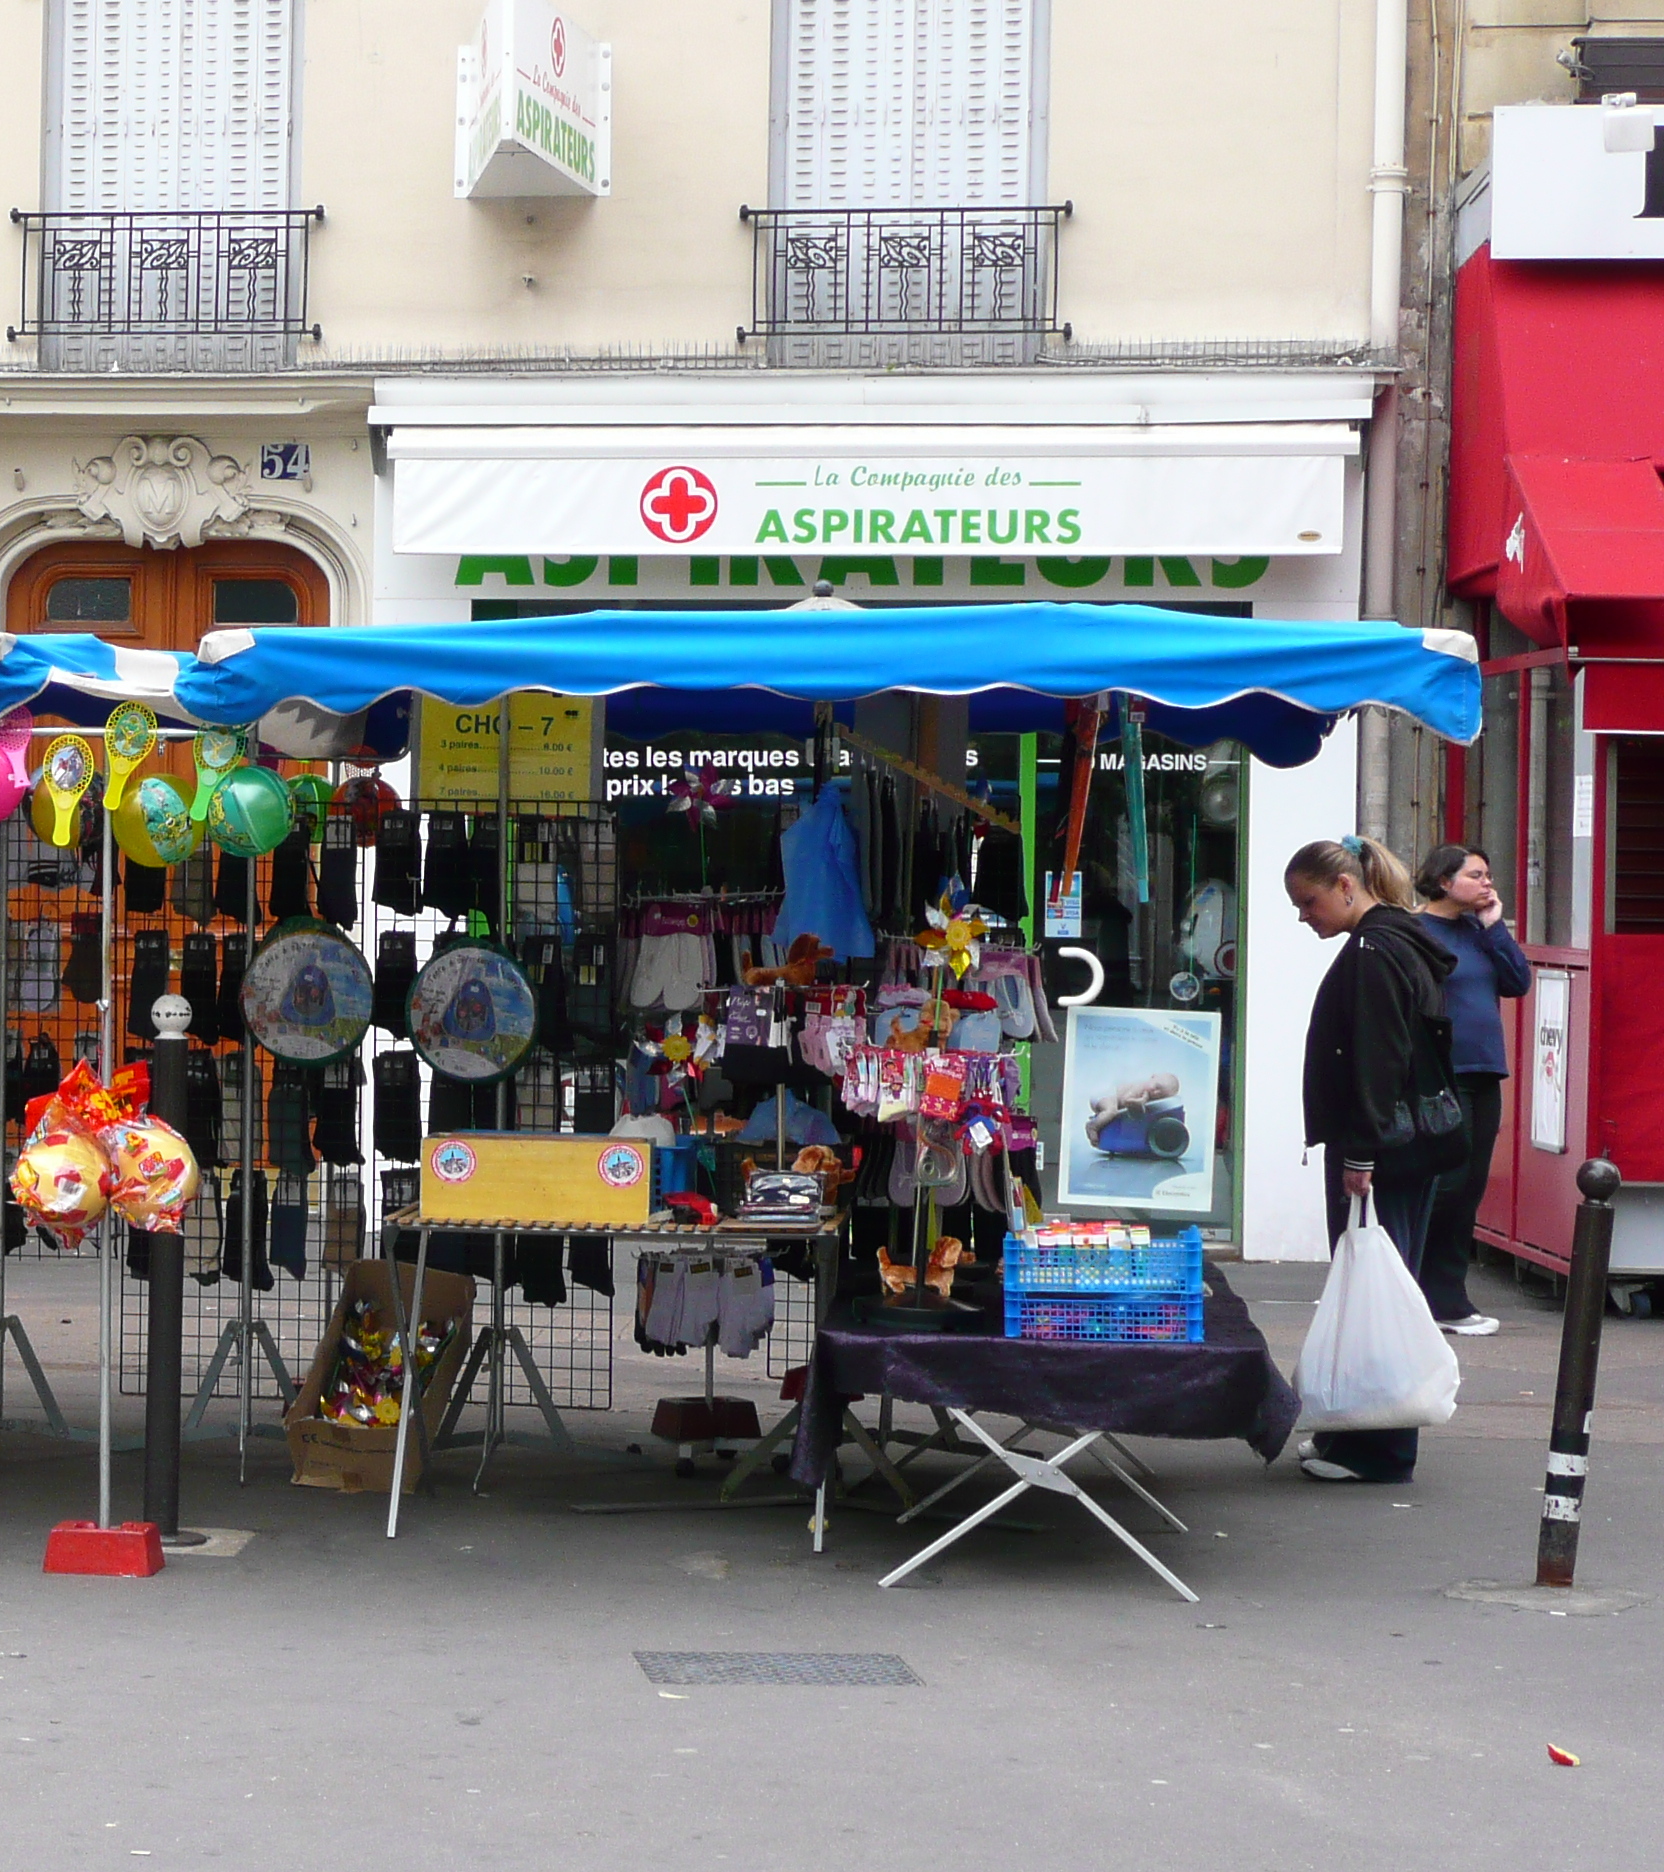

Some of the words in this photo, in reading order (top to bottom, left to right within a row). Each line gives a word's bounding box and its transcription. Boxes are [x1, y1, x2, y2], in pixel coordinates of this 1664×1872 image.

[516, 89, 595, 184] ASPIRATEURS
[262, 443, 309, 479] 54
[813, 464, 841, 488] La
[851, 464, 976, 492] Compagnie
[985, 465, 1022, 488] des
[755, 508, 1083, 545] ASPIRATEURS
[540, 716, 555, 737] 7
[646, 746, 682, 767] les
[689, 749, 799, 772] marques
[606, 774, 655, 802] prix
[748, 774, 795, 796] bas
